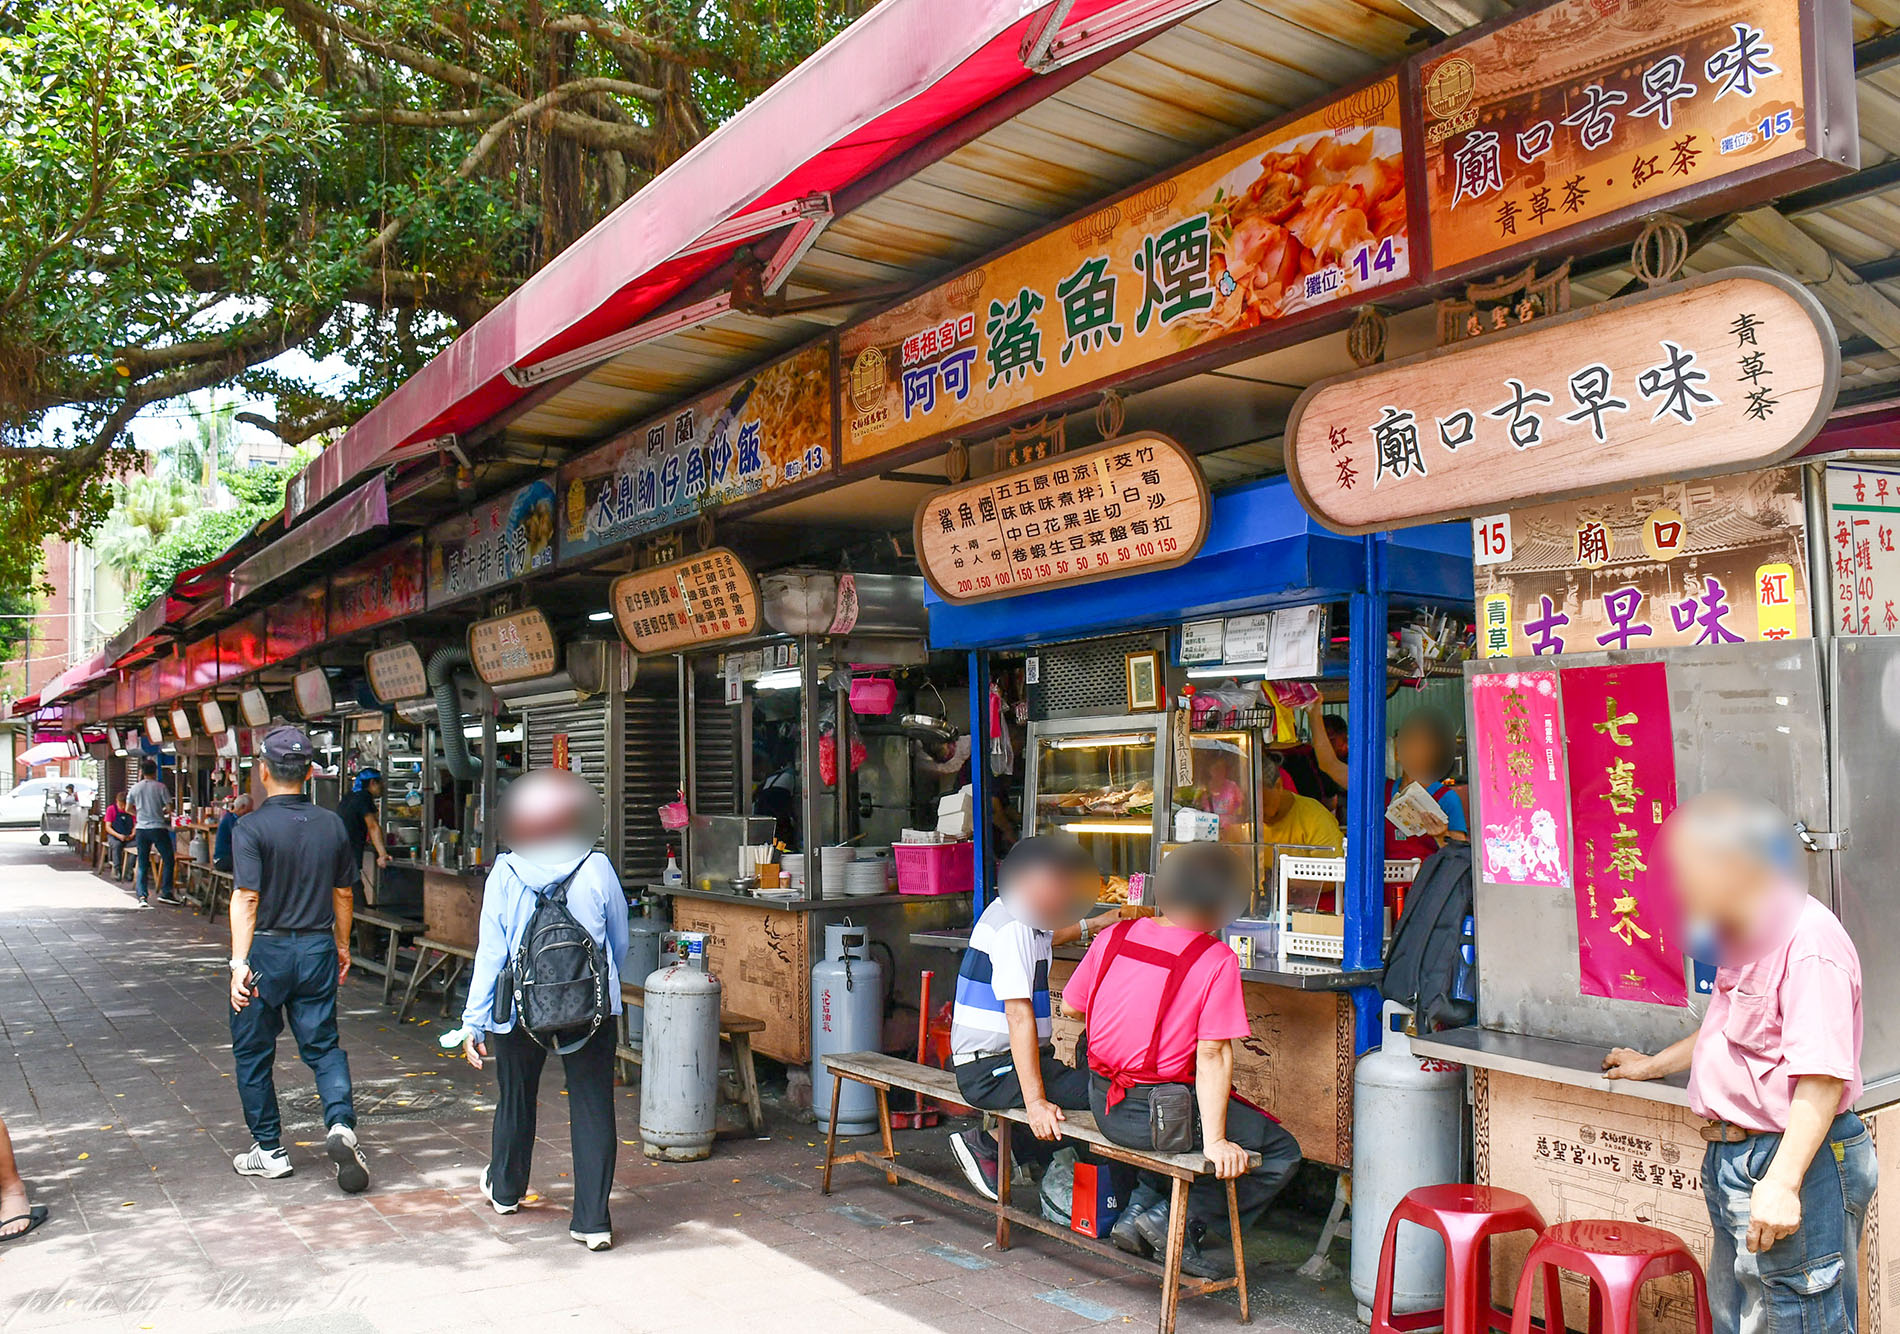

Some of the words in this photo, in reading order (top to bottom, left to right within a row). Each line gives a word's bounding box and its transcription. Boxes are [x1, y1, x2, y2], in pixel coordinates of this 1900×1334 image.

[1450, 22, 1782, 211] 廟口古早味
[1757, 111, 1794, 141] 15
[1351, 237, 1397, 284] 14
[986, 213, 1217, 391] 鯊魚煙
[902, 313, 975, 366] 媽祖宮口
[902, 345, 977, 422] 阿可
[1729, 313, 1781, 422] 青草茶
[647, 408, 695, 457] 阿蘭
[1369, 341, 1722, 490] 廟口古早味
[804, 446, 823, 472] 13
[1327, 424, 1359, 490] 紅茶
[725, 481, 745, 500] Fried
[746, 476, 763, 493] Rice
[1852, 473, 1900, 505] 古早
[938, 494, 997, 535] 鯊魚煙
[1117, 547, 1131, 562] 50
[1135, 541, 1155, 558] 100
[1157, 536, 1178, 553] 150
[1479, 521, 1506, 557] 15
[1576, 519, 1683, 565] 廟口
[1016, 568, 1033, 582] 150
[1034, 563, 1052, 578] 150
[1056, 560, 1068, 575] 50
[1076, 556, 1089, 571] 50
[1096, 551, 1110, 567] 50
[957, 578, 973, 593] 200
[976, 575, 992, 590] 150
[994, 571, 1010, 585] 100
[1486, 601, 1509, 658] 青草
[1523, 577, 1746, 657] 古早味
[1593, 696, 1652, 947] 七喜春來
[1536, 1136, 1622, 1173] 慈聖宮小吃
